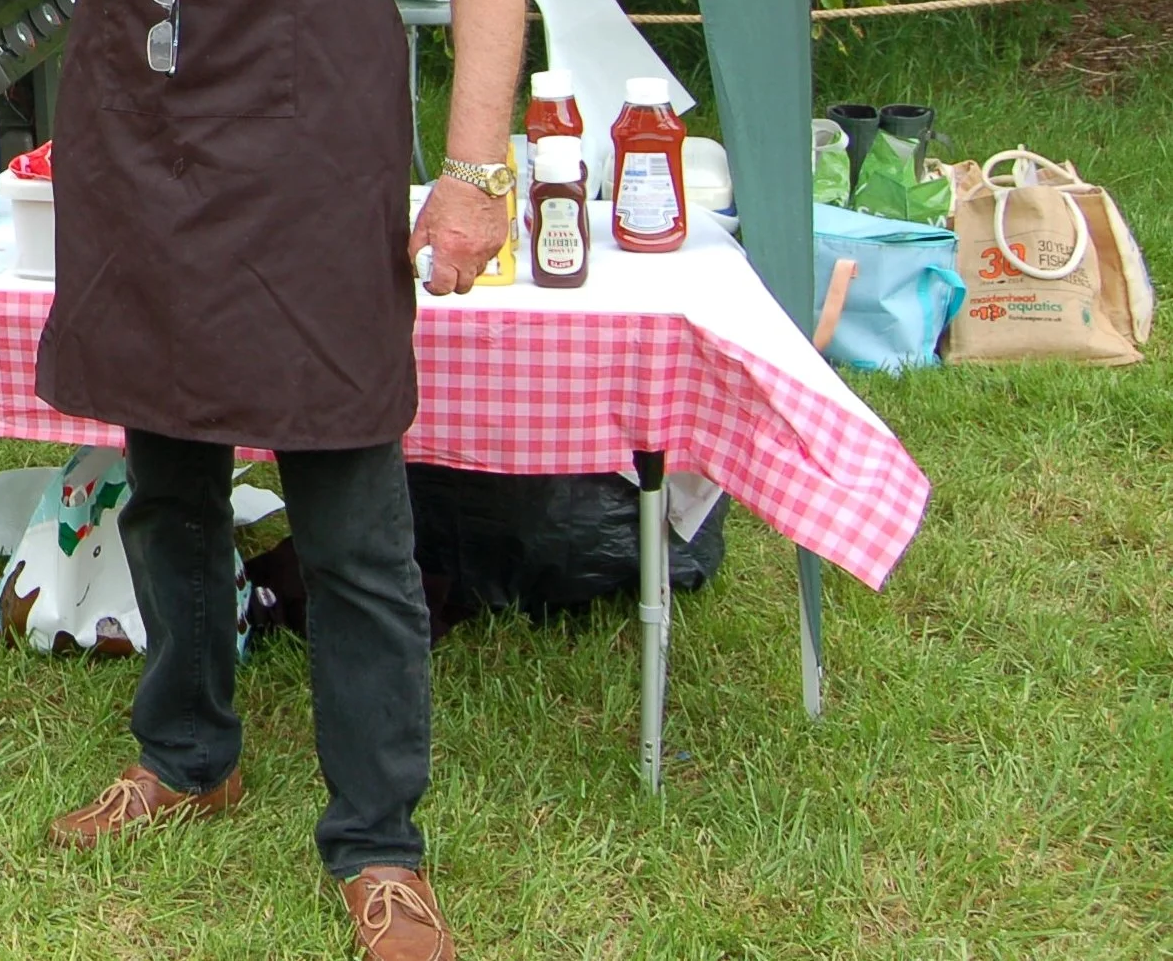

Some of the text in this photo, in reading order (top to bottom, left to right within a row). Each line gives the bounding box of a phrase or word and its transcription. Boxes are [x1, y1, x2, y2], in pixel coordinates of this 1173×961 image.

[1037, 240, 1053, 252] 30
[979, 243, 1026, 279] 30
[1007, 300, 1063, 314] aquatics
